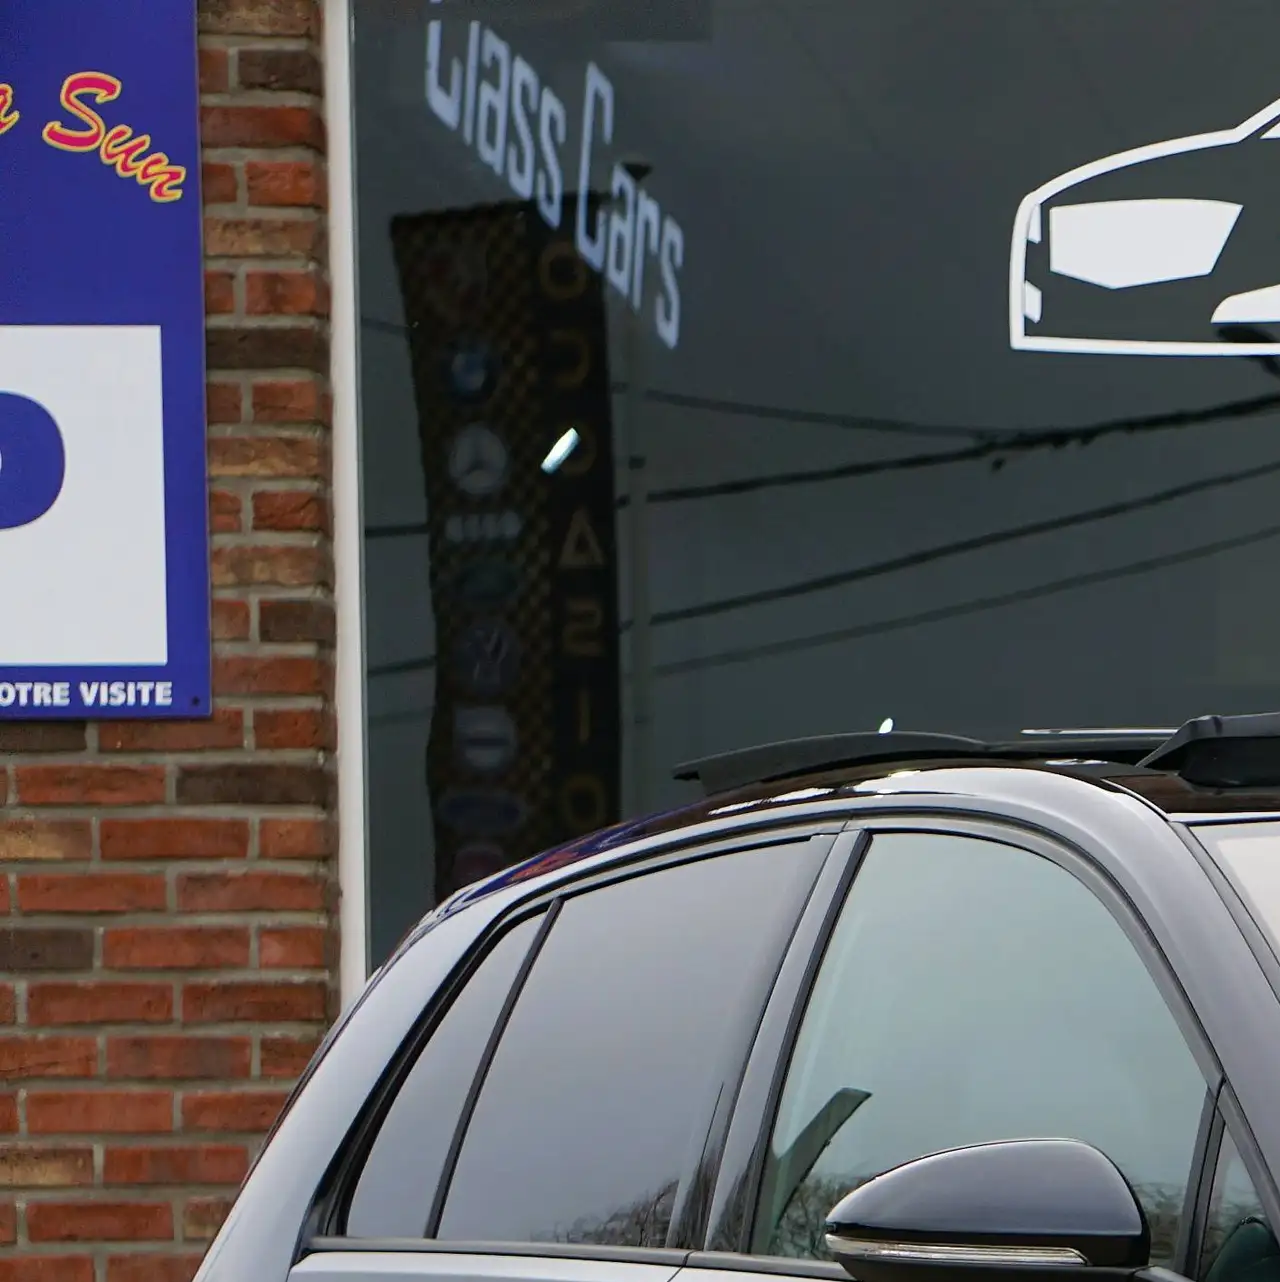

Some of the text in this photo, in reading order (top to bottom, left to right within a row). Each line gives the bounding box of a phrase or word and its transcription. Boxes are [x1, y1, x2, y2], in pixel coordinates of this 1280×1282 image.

[42, 71, 187, 203] Sun
[424, 0, 684, 349] Class Cars
[79, 681, 173, 707] VISITE
